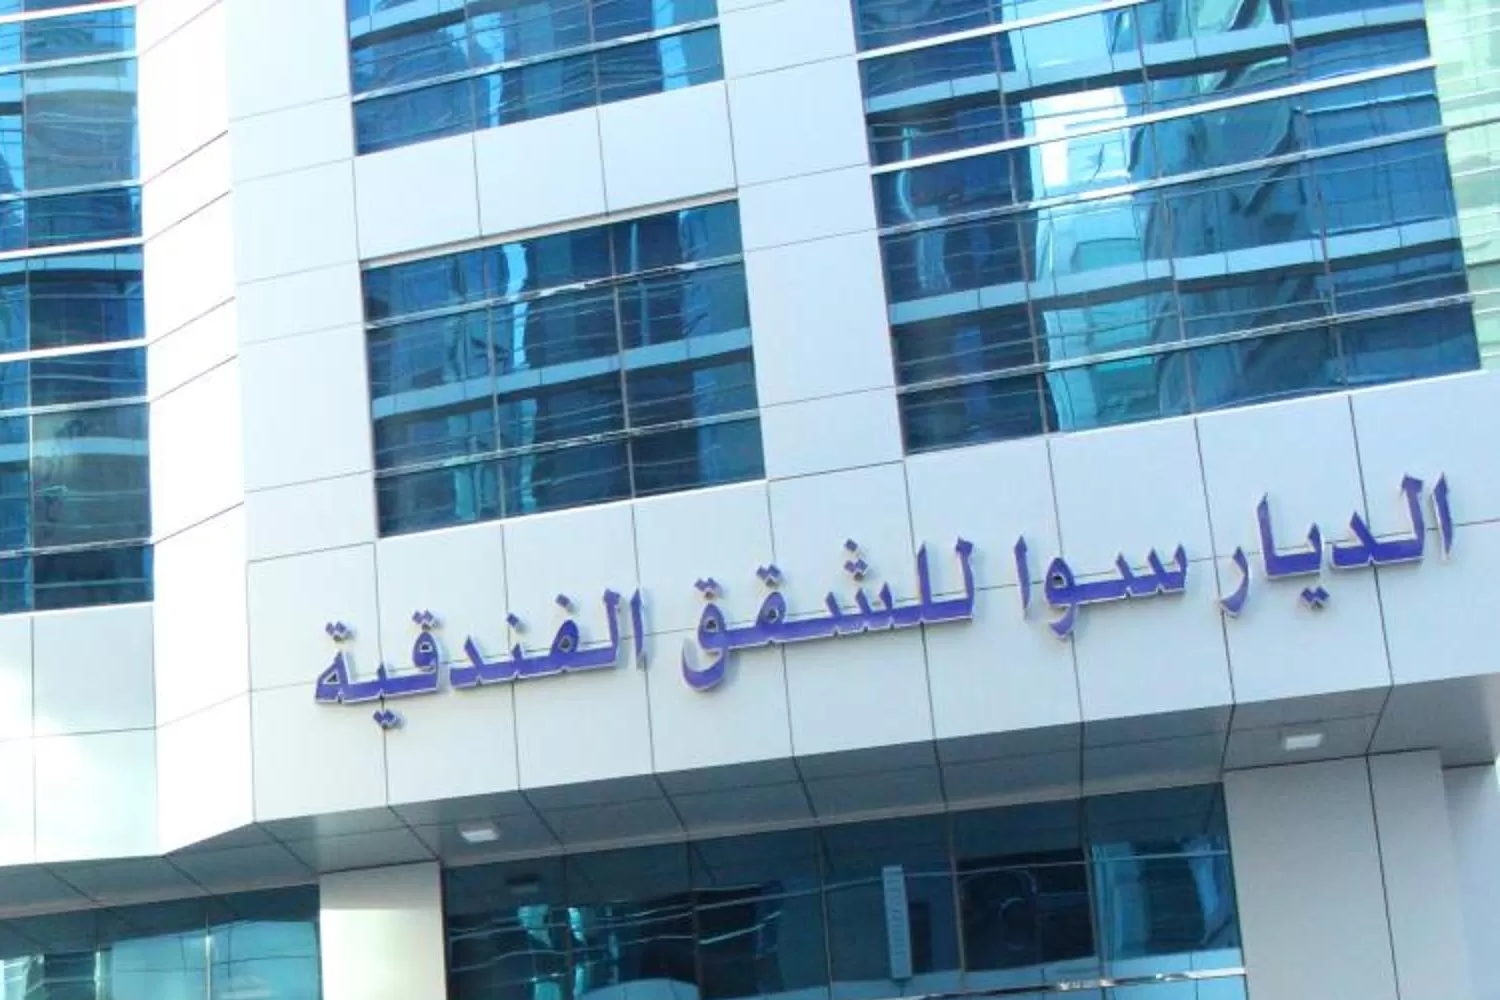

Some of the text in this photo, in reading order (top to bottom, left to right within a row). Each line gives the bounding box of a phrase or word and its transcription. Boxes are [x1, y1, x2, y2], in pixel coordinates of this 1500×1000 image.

[314, 473, 1454, 731] الديار سوا للشقق الفندقية
